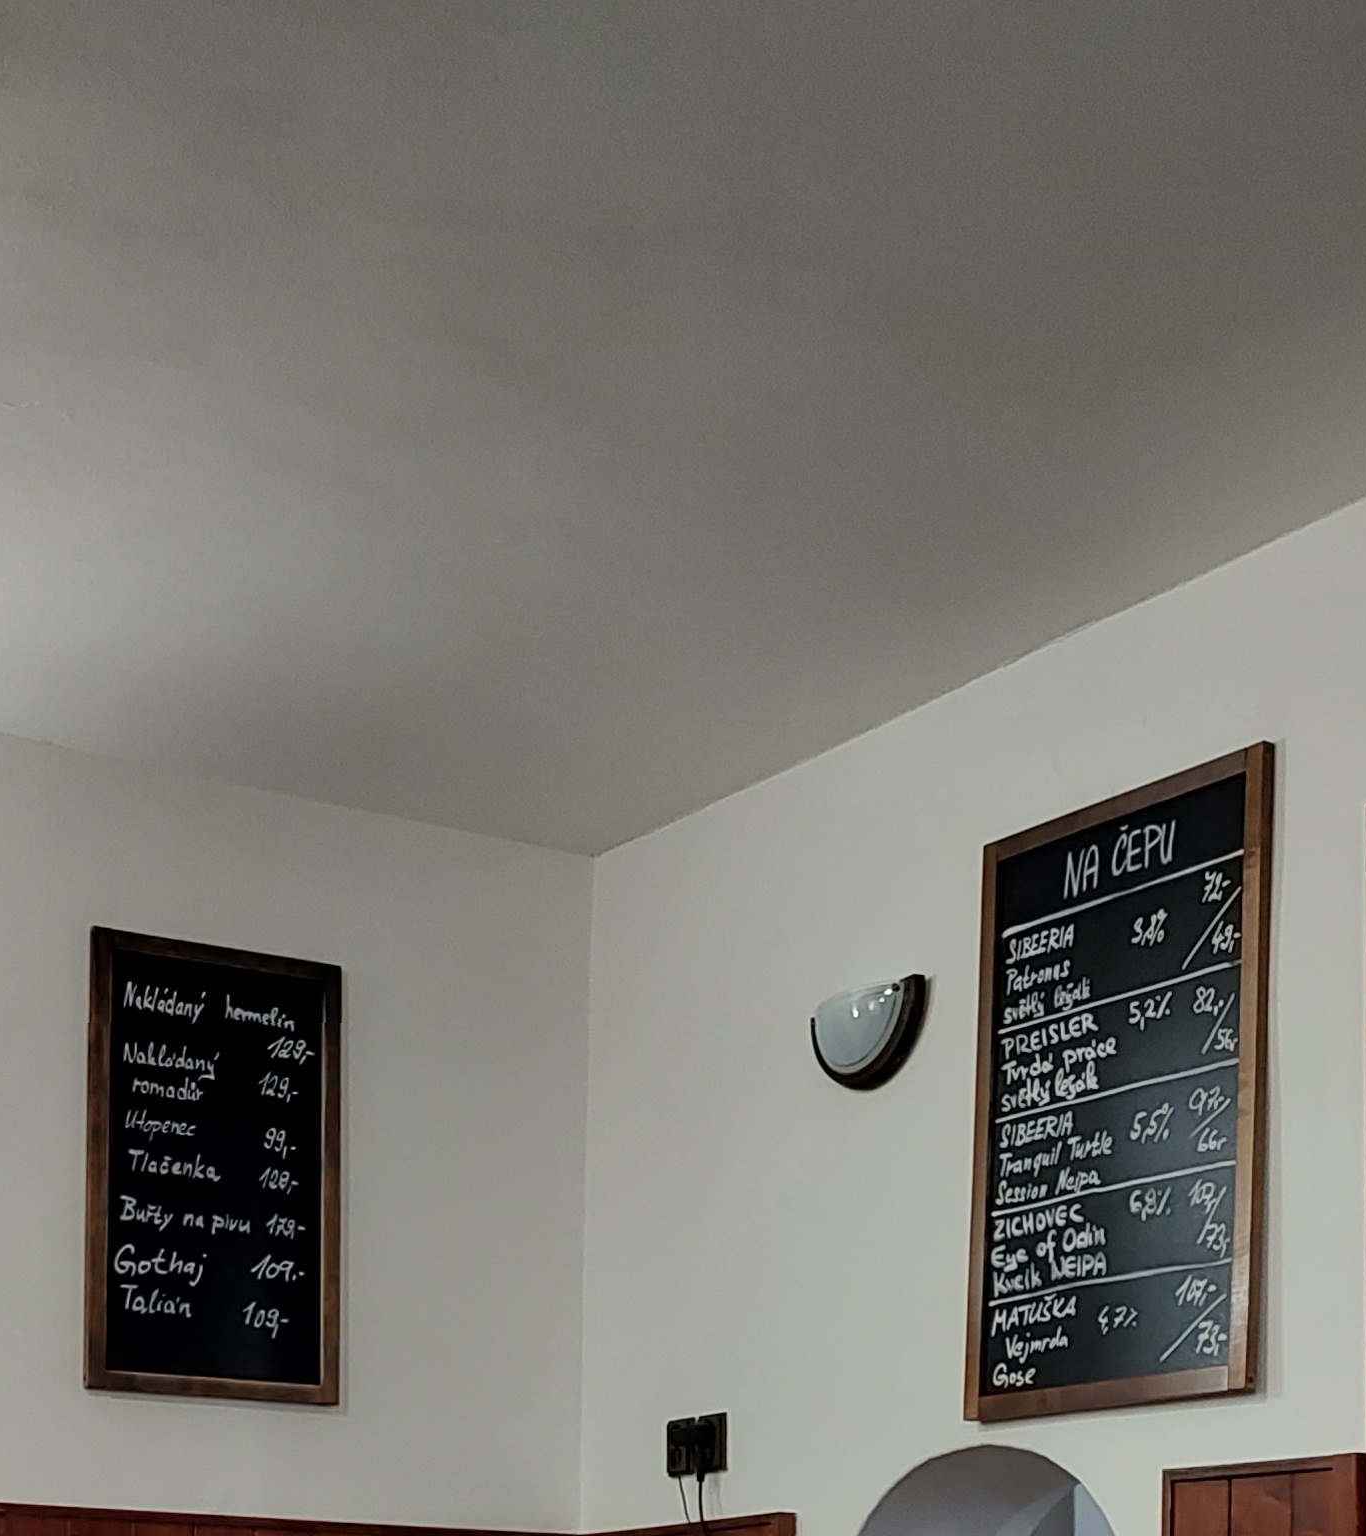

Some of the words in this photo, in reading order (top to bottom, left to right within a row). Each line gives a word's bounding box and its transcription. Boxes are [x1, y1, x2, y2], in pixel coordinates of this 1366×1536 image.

[1063, 844, 1100, 900] NA
[1111, 819, 1176, 877] ČEPU
[1005, 924, 1075, 965] SIBEERIA
[123, 981, 207, 1024] Nakládaný
[225, 993, 295, 1032] hermelin
[1001, 1012, 1100, 1060] PREISLER
[1128, 990, 1173, 1031] 5,2%
[267, 1036, 315, 1065] 129,-
[1001, 1052, 1054, 1086] Tvrdá
[1062, 1036, 1118, 1074] práce
[258, 1072, 299, 1103] 129,-
[125, 1109, 197, 1142] Utopenec
[263, 1127, 297, 1160] 99,-
[999, 1110, 1074, 1149] SIBEERIA
[1129, 1102, 1174, 1144] 5,5%
[128, 1149, 222, 1182] Tlačenka
[998, 1141, 1062, 1178] Tranquil
[1066, 1130, 1114, 1160] Turtle
[120, 1195, 174, 1232] Buřty
[183, 1213, 204, 1228] na
[211, 1213, 251, 1235] pivu
[994, 1180, 1049, 1206] Session
[993, 1203, 1085, 1242] ZICHOVEC
[113, 1243, 208, 1287] Gothaj
[991, 1244, 1030, 1273] Eye
[1036, 1229, 1057, 1264] of
[1051, 1251, 1108, 1282] NEIPA
[119, 1284, 192, 1319] Talián
[241, 1301, 290, 1339] 109,-
[991, 1294, 1078, 1338] MATUŠKA
[1004, 1326, 1070, 1364] Vejmrda
[992, 1364, 1037, 1389] Gose
